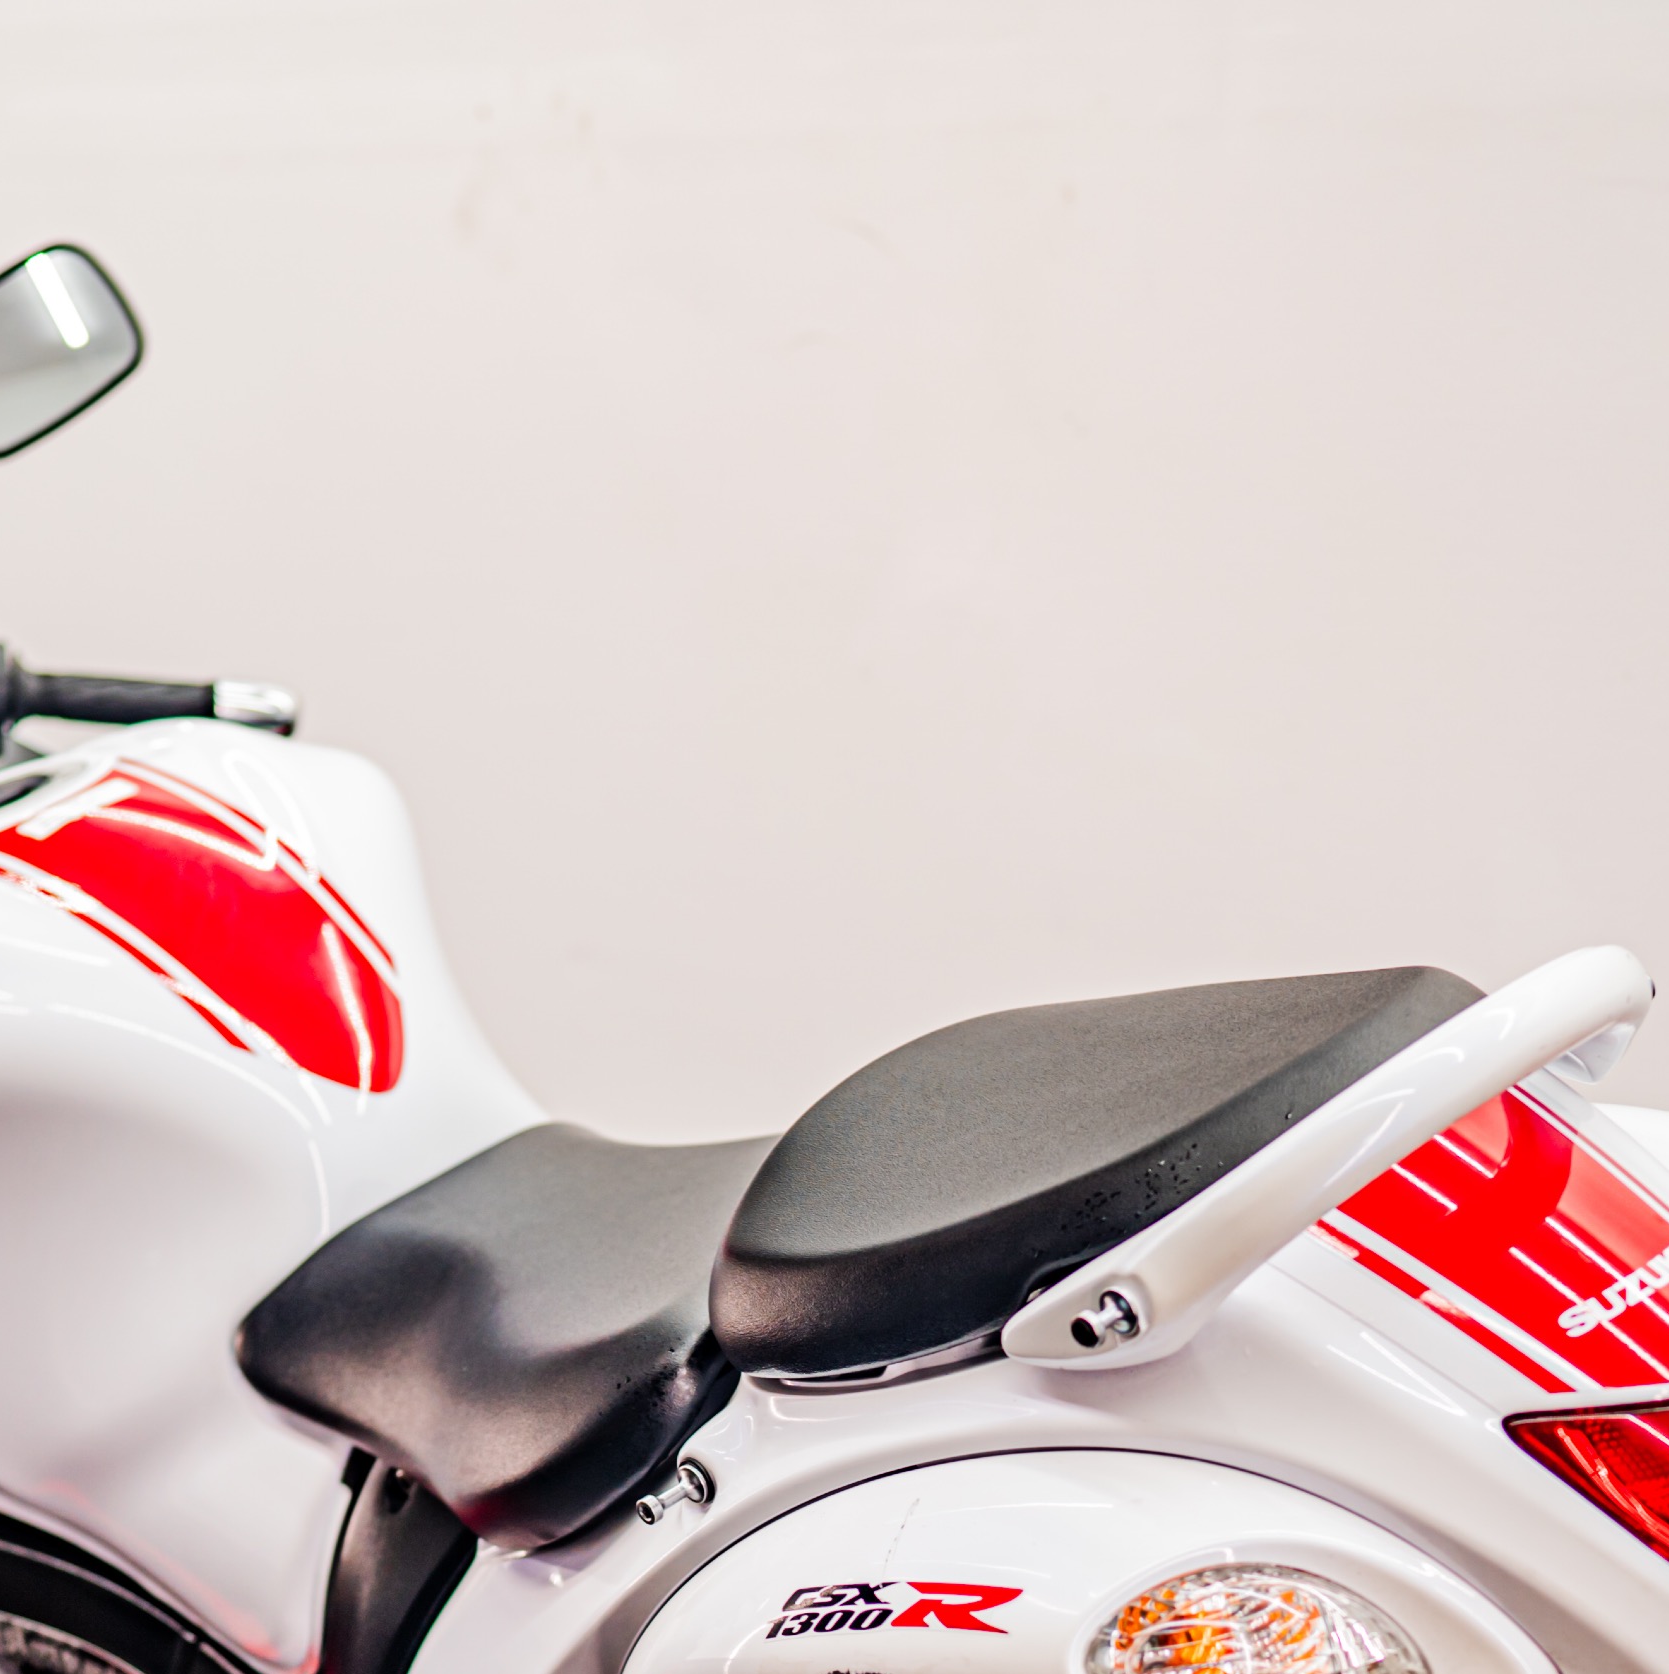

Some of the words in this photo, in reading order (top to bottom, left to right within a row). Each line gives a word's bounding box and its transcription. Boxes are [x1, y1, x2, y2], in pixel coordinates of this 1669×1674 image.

[765, 1608, 894, 1639] 1300
[782, 1581, 900, 1611] GSX
[890, 1581, 1024, 1634] R
